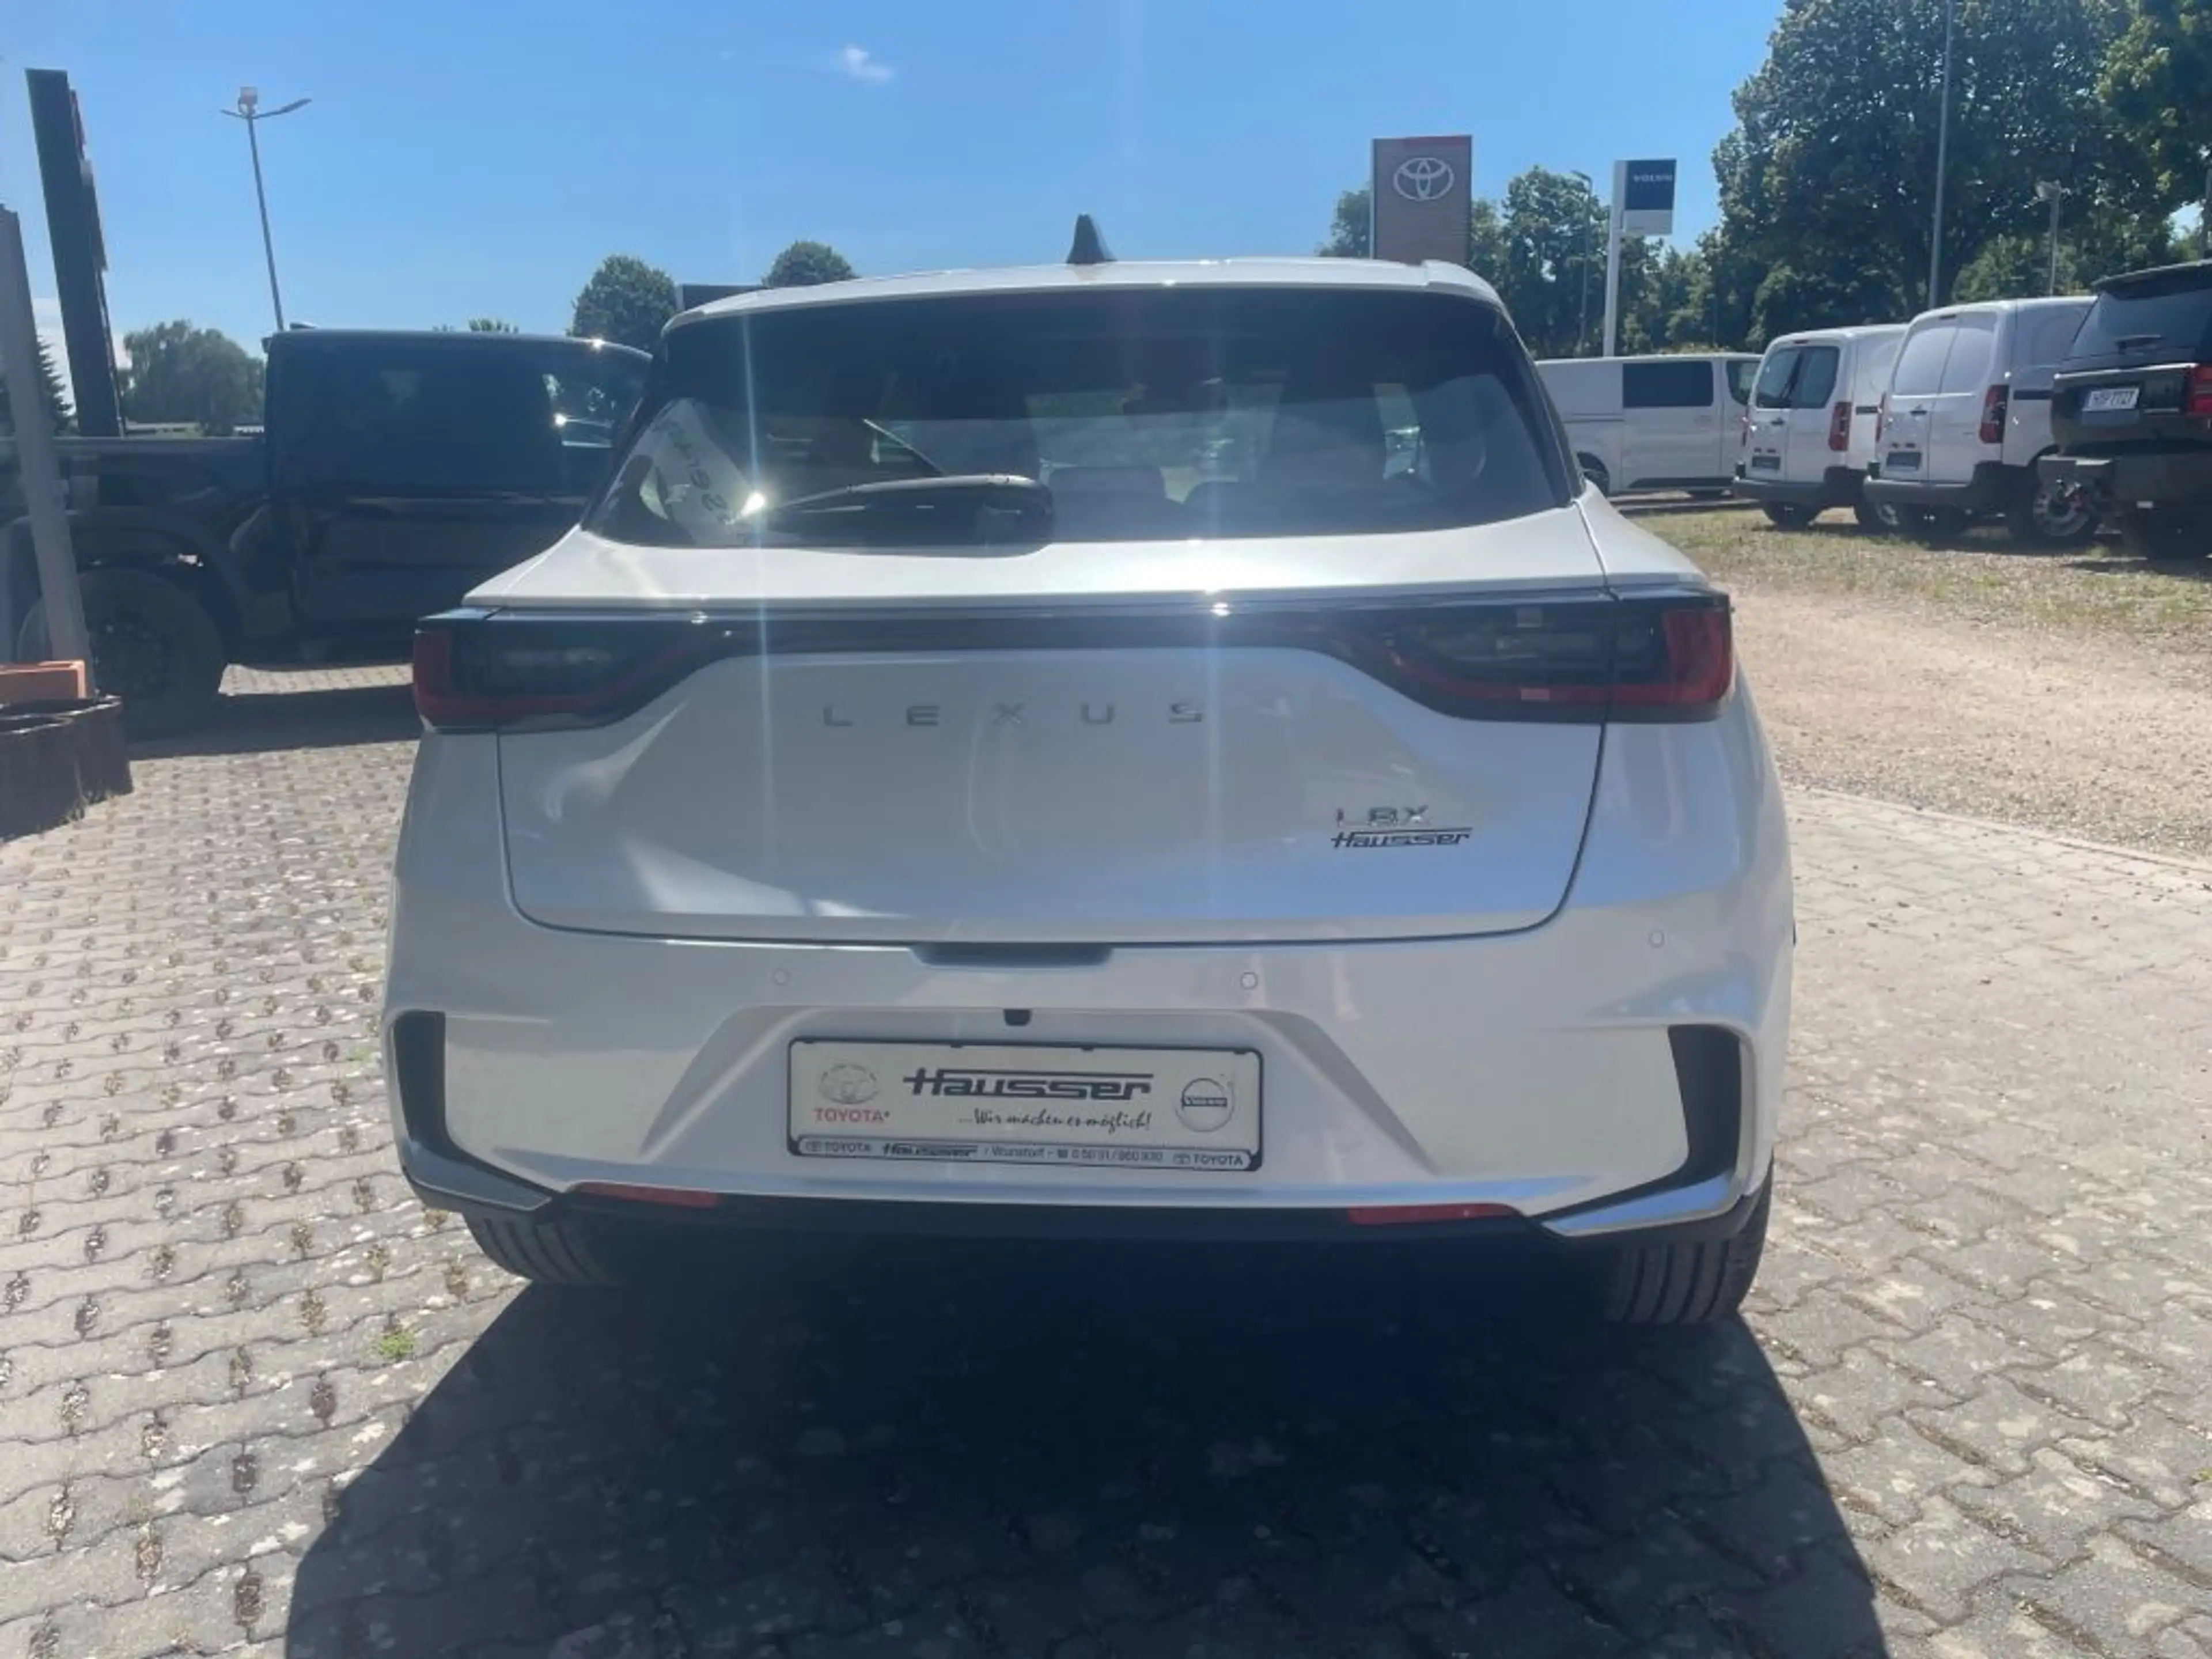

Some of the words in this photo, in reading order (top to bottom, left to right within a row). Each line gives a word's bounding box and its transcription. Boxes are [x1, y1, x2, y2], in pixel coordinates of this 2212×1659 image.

[823, 702, 1204, 727] LEXUS
[1331, 828, 1473, 849] Hausser
[903, 1067, 1154, 1101] Hausser
[813, 1107, 884, 1123] TOYOTA
[1194, 1153, 1243, 1166] TOYOTA
